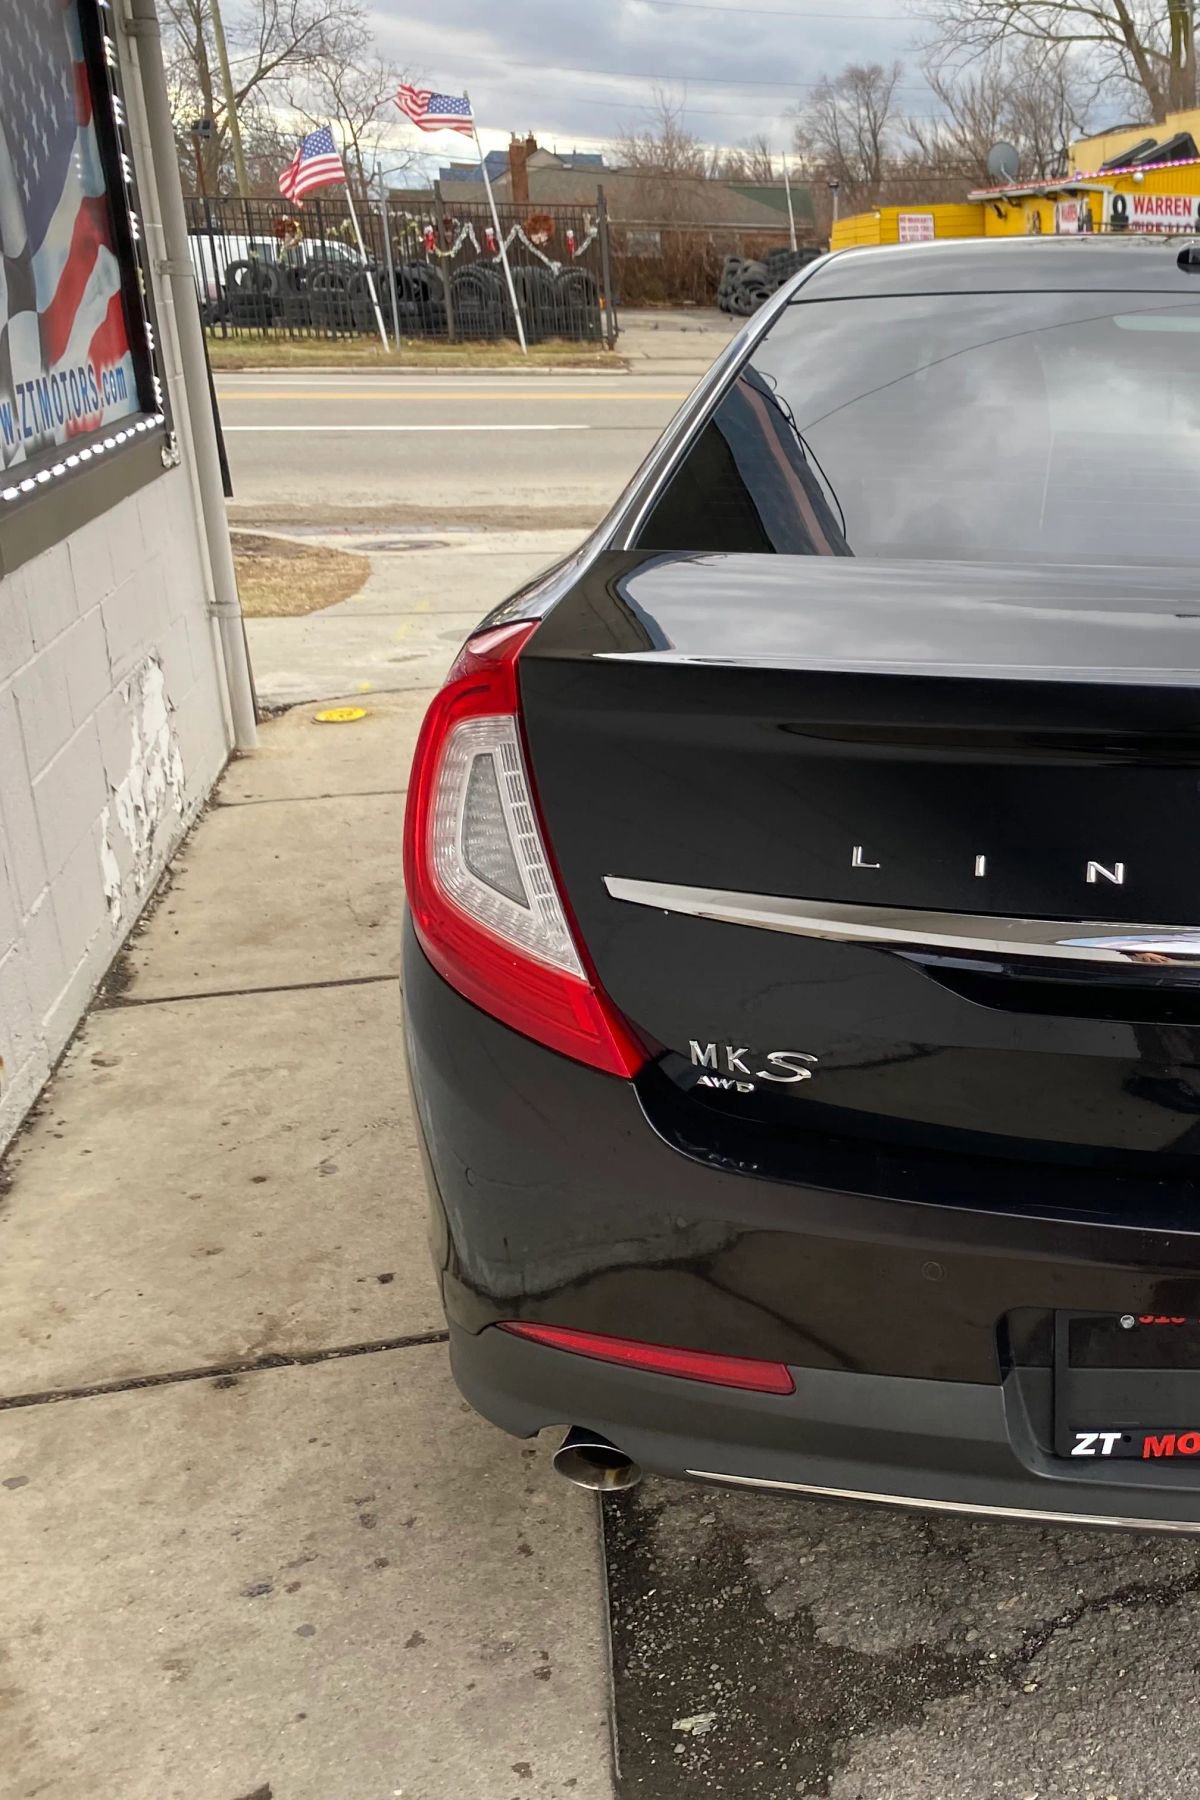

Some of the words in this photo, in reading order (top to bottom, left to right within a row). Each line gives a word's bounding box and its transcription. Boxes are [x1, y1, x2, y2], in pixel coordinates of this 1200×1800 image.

[1133, 195, 1192, 217] WARREN
[689, 1039, 819, 1082] MKS
[696, 1075, 755, 1093] AWD
[1071, 1432, 1123, 1456] ZT
